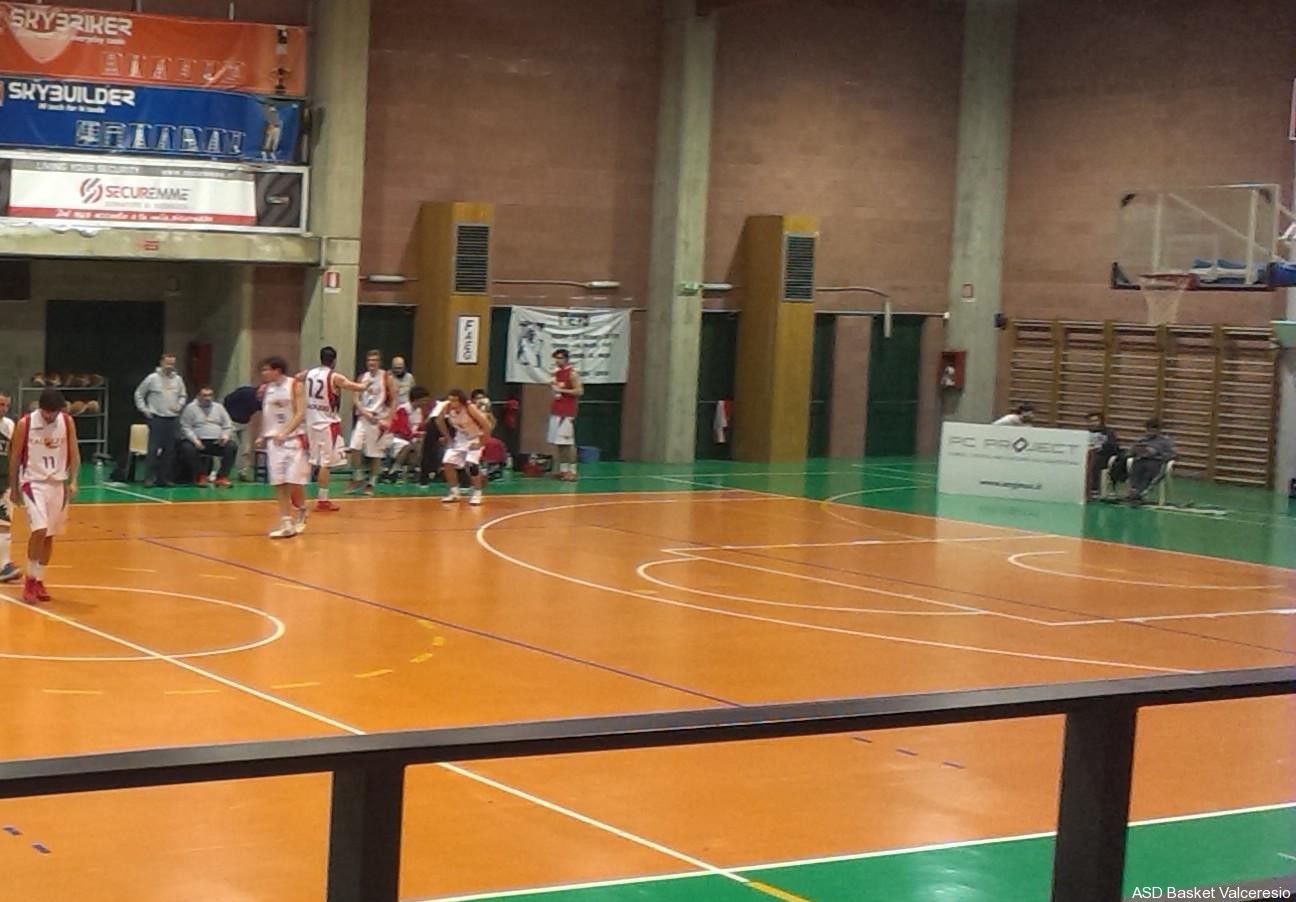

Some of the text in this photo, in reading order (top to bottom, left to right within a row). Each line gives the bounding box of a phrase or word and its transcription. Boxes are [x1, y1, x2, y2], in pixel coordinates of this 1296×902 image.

[9, 8, 133, 36] SKYBRIKER
[8, 82, 135, 107] SKYBUILDER
[105, 186, 191, 201] SECUREMME
[308, 378, 324, 399] 12
[948, 436, 1080, 454] PC PROJECT
[42, 456, 55, 469] 11
